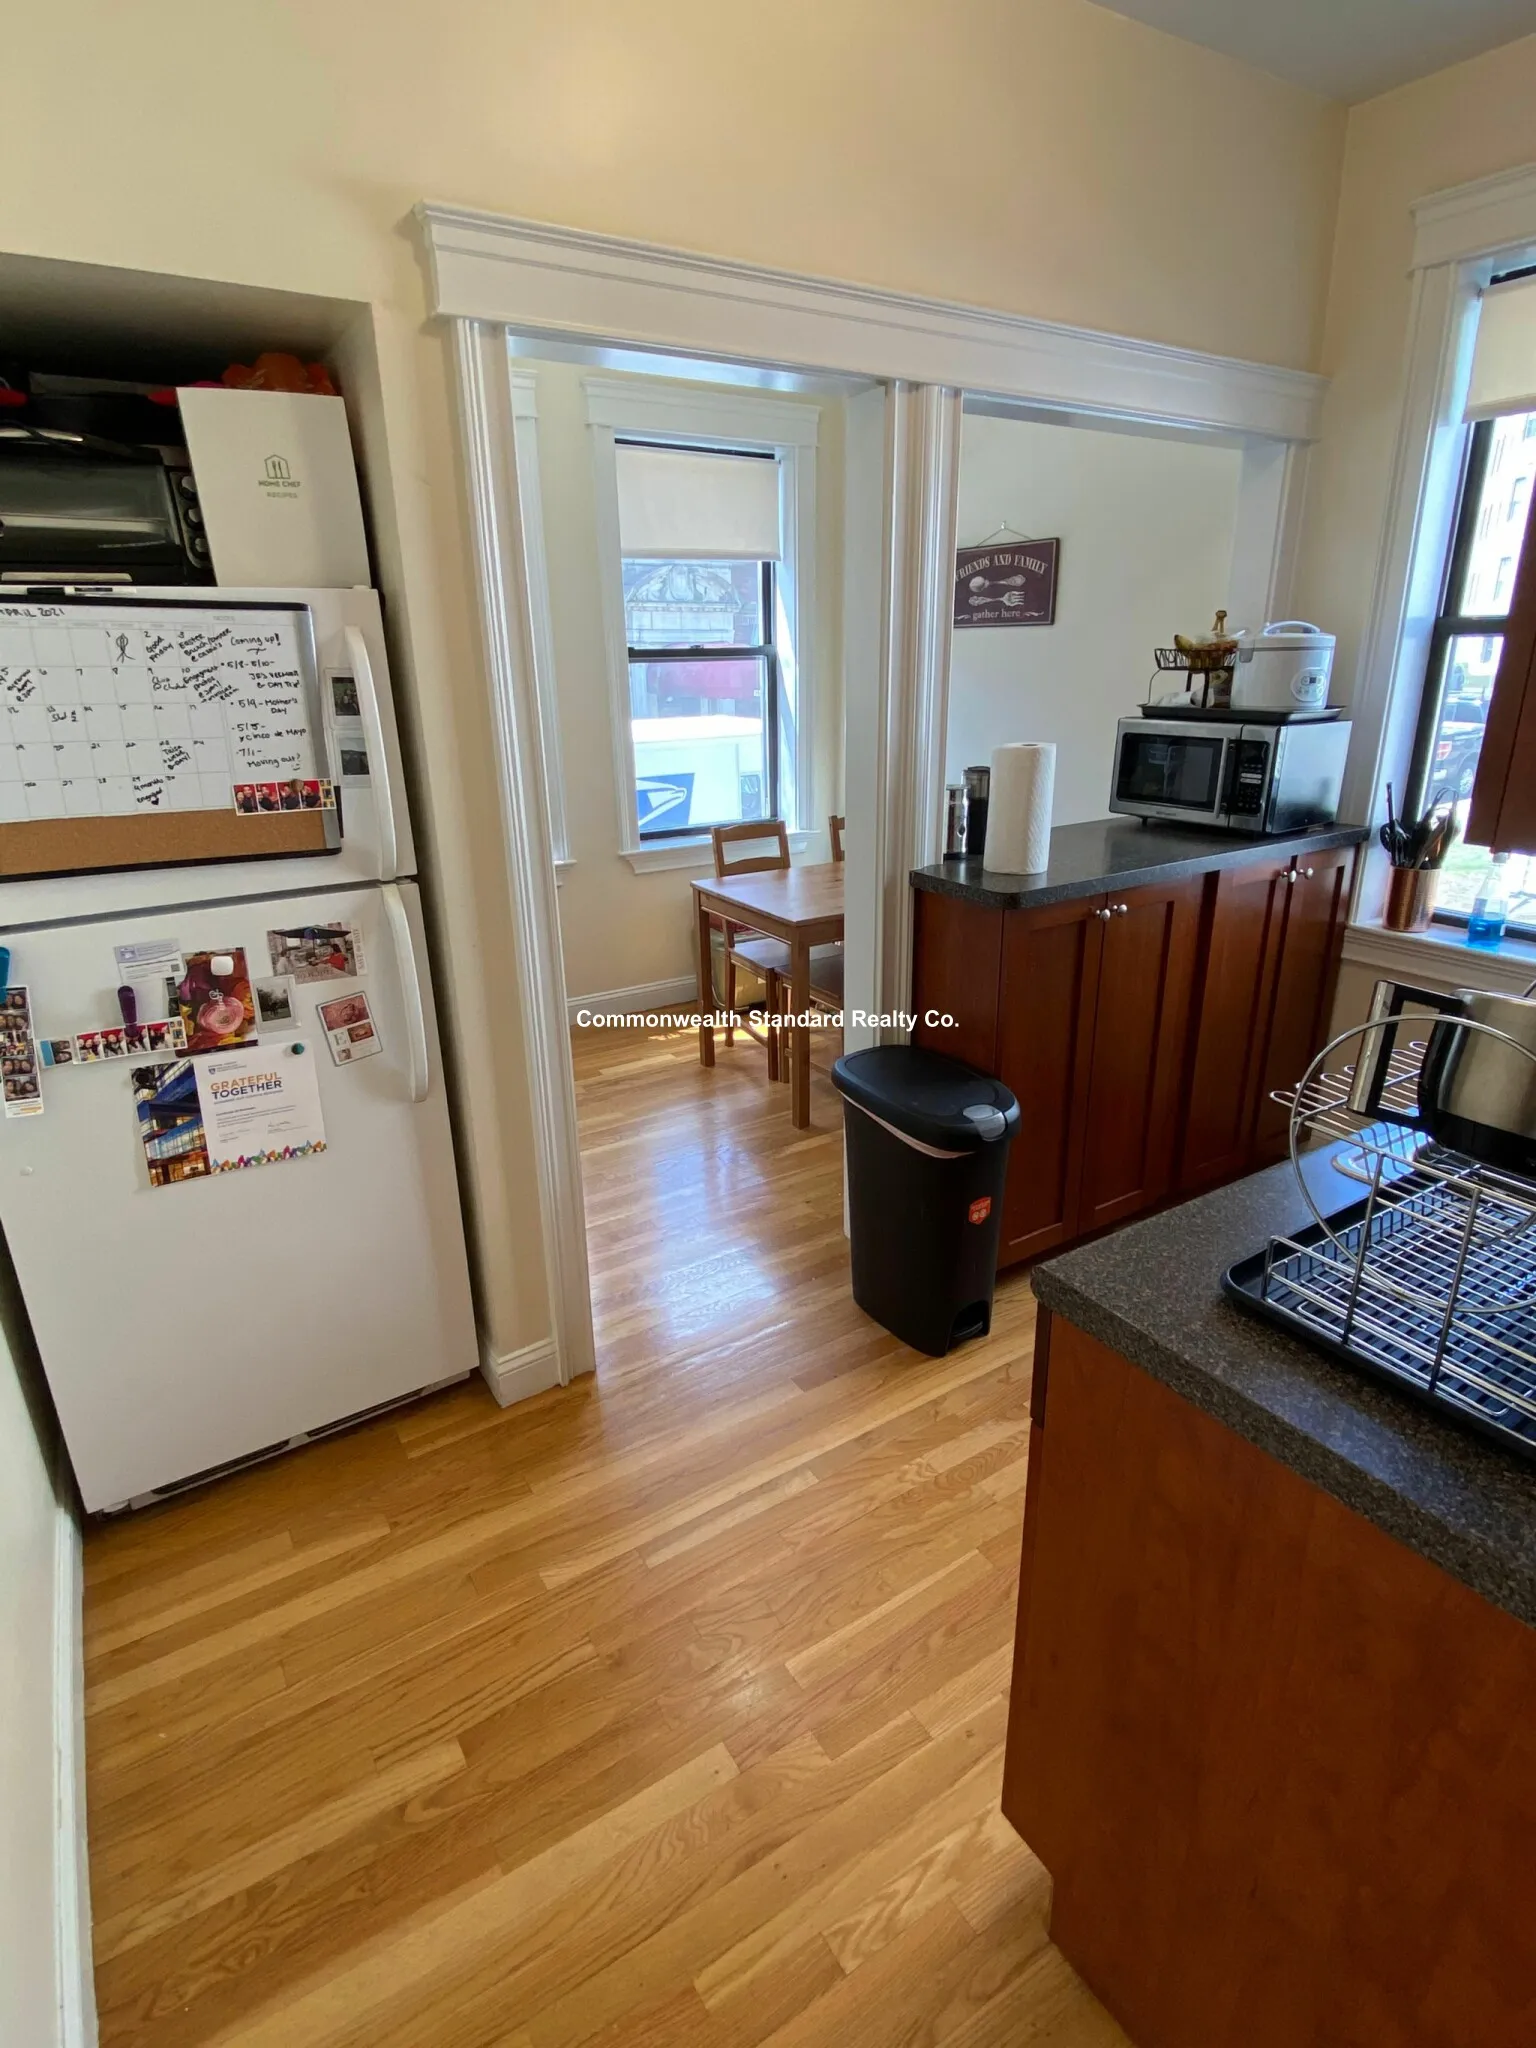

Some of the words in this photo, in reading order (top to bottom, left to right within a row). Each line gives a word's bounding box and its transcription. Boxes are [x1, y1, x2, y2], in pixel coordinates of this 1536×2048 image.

[281, 480, 301, 488] CHEF
[993, 553, 1012, 566] AND
[1013, 554, 1048, 575] FAMILY
[37, 607, 65, 617] 2021
[972, 608, 999, 621] gather
[1001, 608, 1021, 618] here
[145, 635, 165, 654] Good
[230, 636, 263, 646] Coming
[264, 632, 281, 646] up!
[7, 706, 20, 714] 12
[270, 707, 288, 715] DAY
[246, 758, 280, 769] Moving
[210, 1071, 282, 1092] GRATEFUL
[211, 1079, 282, 1100] TOGETHER
